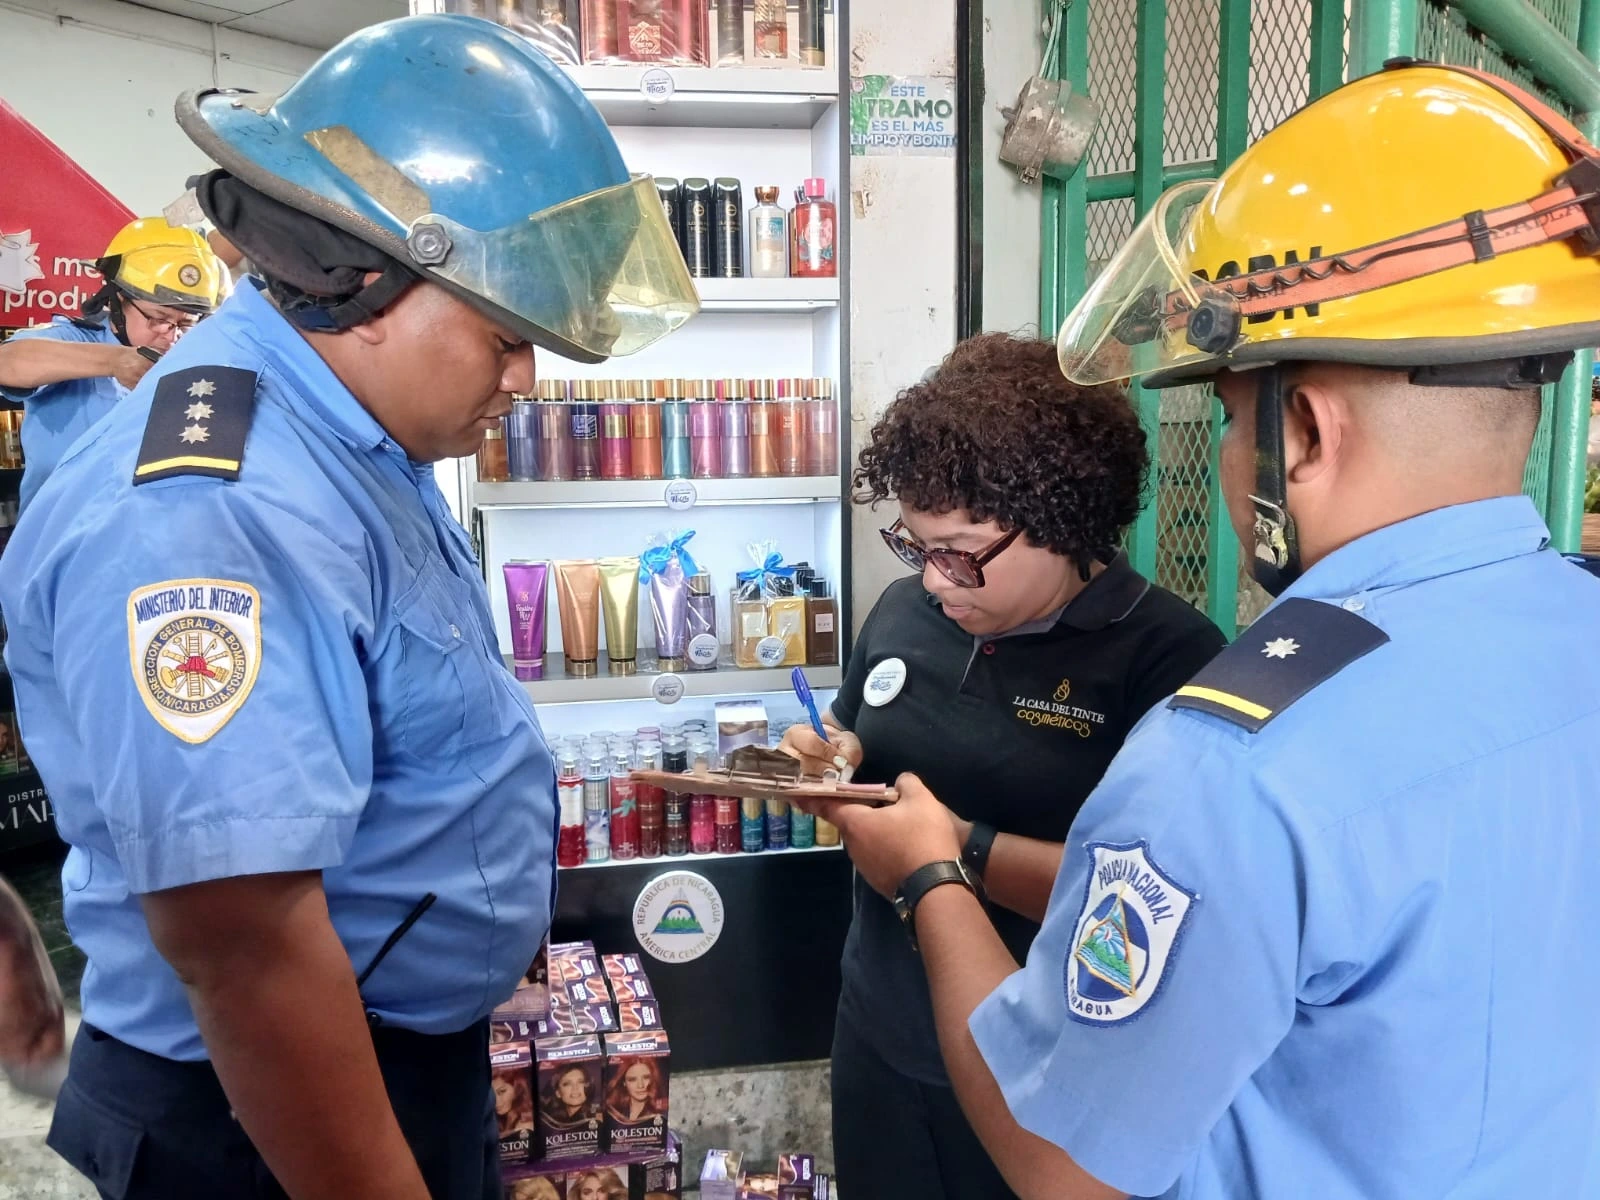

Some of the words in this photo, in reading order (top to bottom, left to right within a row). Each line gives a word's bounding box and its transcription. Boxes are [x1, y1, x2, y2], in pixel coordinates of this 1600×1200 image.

[890, 85, 926, 98] ESTE
[863, 98, 953, 119] TRAMO
[872, 120, 889, 131] ES
[893, 120, 909, 132] EL
[134, 588, 186, 624] MINISTERIO
[188, 587, 206, 610] DEL
[208, 587, 253, 619] INTERIOR
[160, 618, 210, 641] GENERAL
[212, 622, 227, 639] DE
[227, 636, 245, 695] BOMBEROS
[163, 692, 229, 713] NICARAGUA
[1012, 696, 1026, 707] LA
[1026, 698, 1050, 711] CASA
[1051, 703, 1071, 716] DEL
[1071, 706, 1105, 724] TINTE
[637, 881, 670, 924] REPUBLICA
[672, 877, 686, 887] DE
[687, 878, 721, 923] NICARAGUA
[1126, 861, 1174, 925] NACIONAL
[640, 932, 676, 959] AMERICA
[678, 931, 716, 960] CENTRAL
[545, 1130, 598, 1146] KOLESTON
[610, 1126, 663, 1139] KOLESTON
